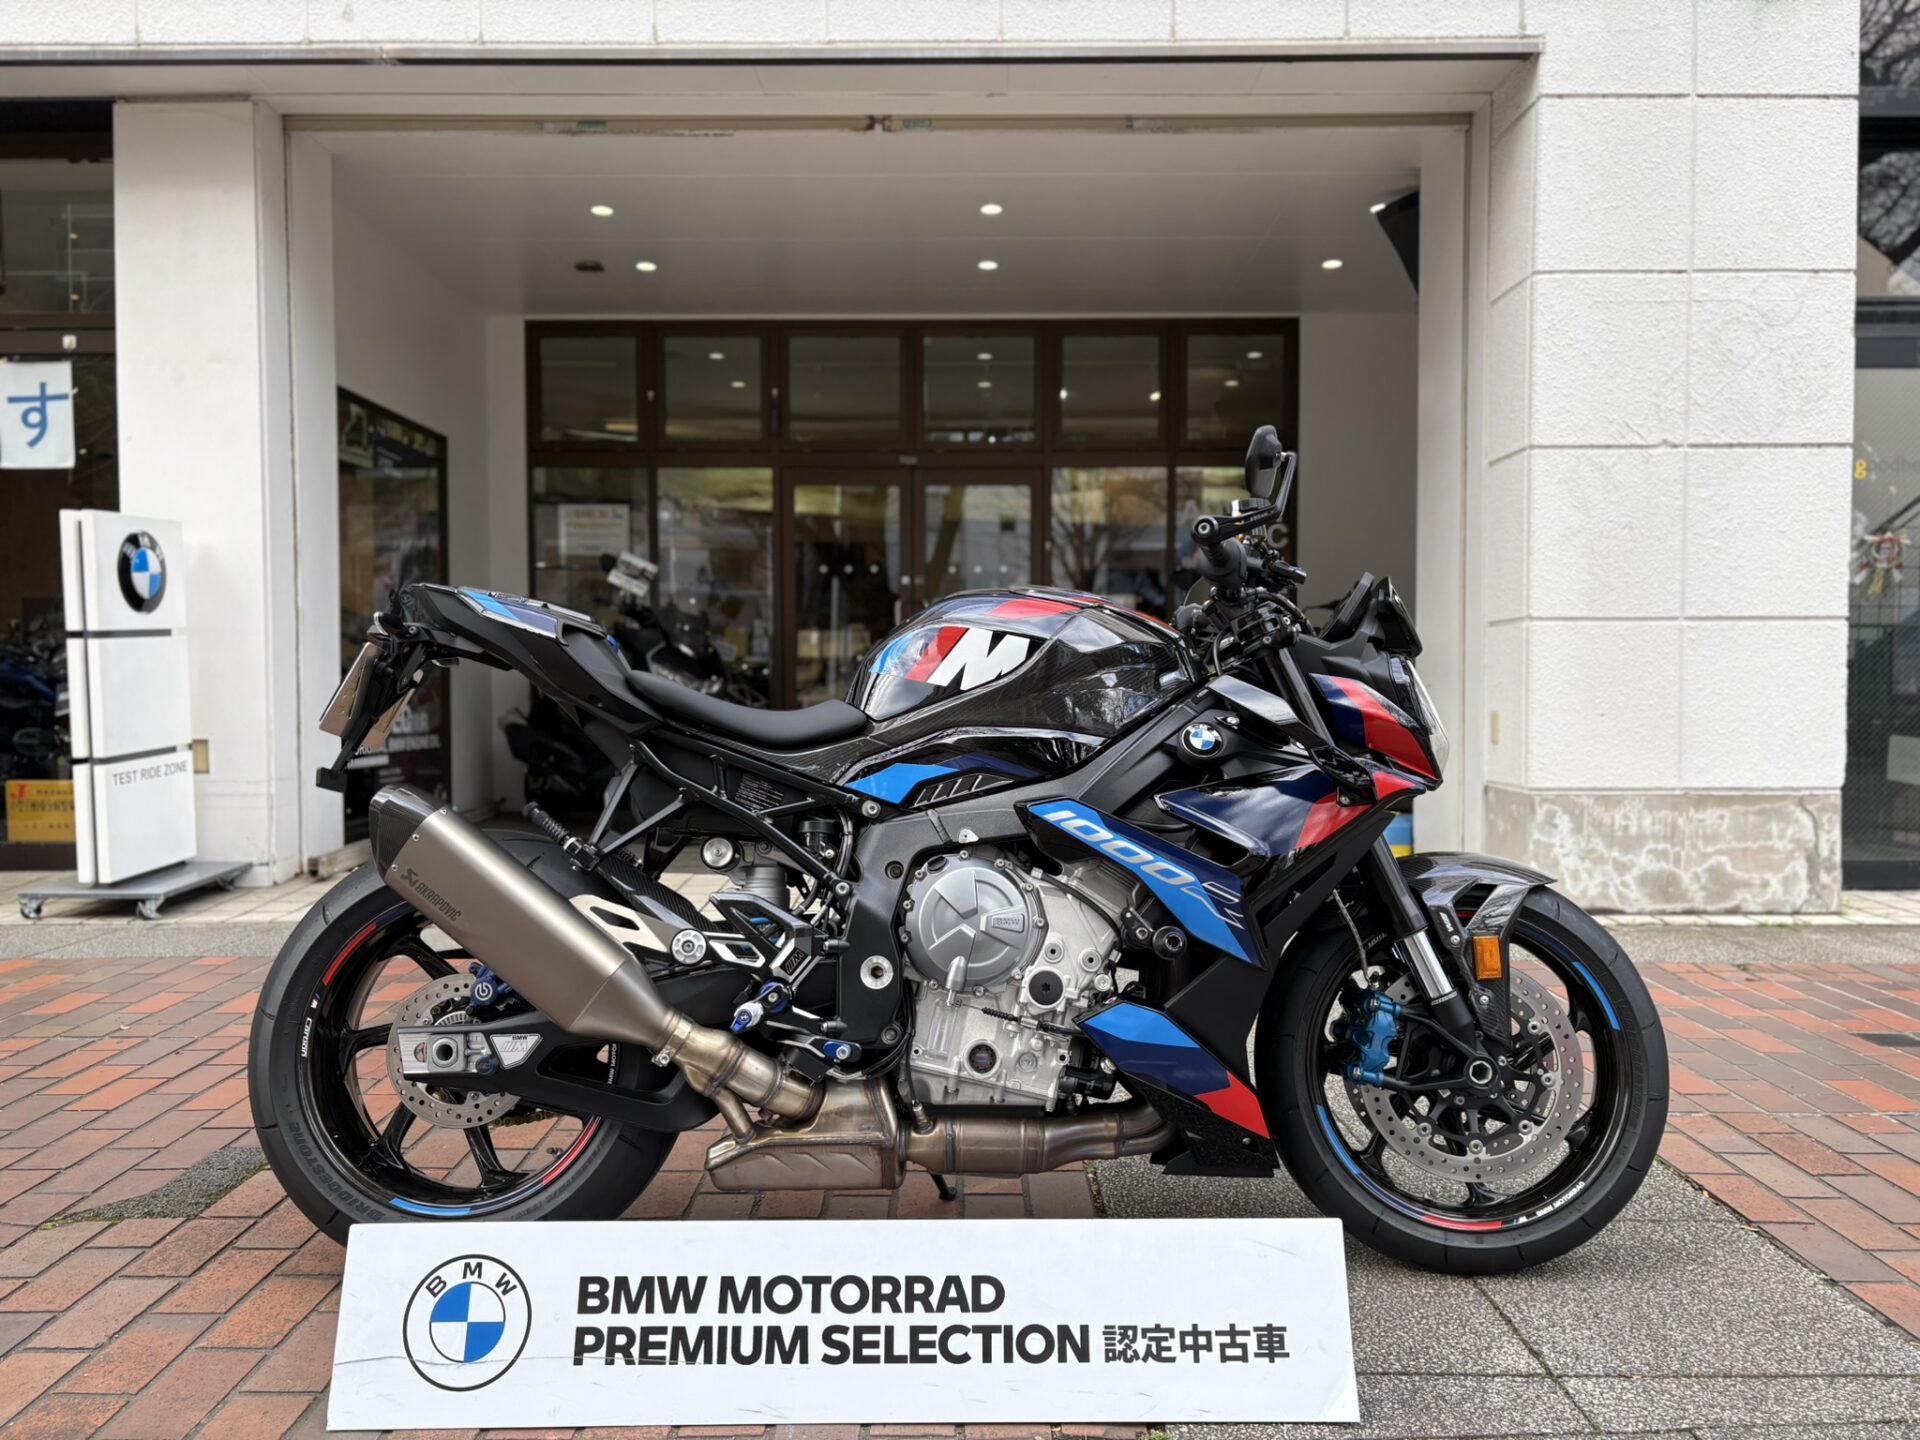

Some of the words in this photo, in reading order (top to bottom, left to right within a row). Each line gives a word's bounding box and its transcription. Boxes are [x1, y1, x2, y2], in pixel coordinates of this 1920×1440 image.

[6, 381, 70, 448] す
[112, 770, 138, 787] TEST
[140, 765, 162, 782] RIDE
[163, 760, 188, 778] ZONE
[1043, 809, 1198, 886] 1000
[1553, 1180, 1586, 1208] MOTORRAD
[425, 1262, 518, 1299] BMW
[577, 1275, 708, 1315] BMW
[717, 1274, 1006, 1315] MOTORRAD
[572, 1325, 810, 1366] PREMIUM
[820, 1323, 1091, 1366] SELECTION
[1102, 1323, 1290, 1364] 認定中古車
